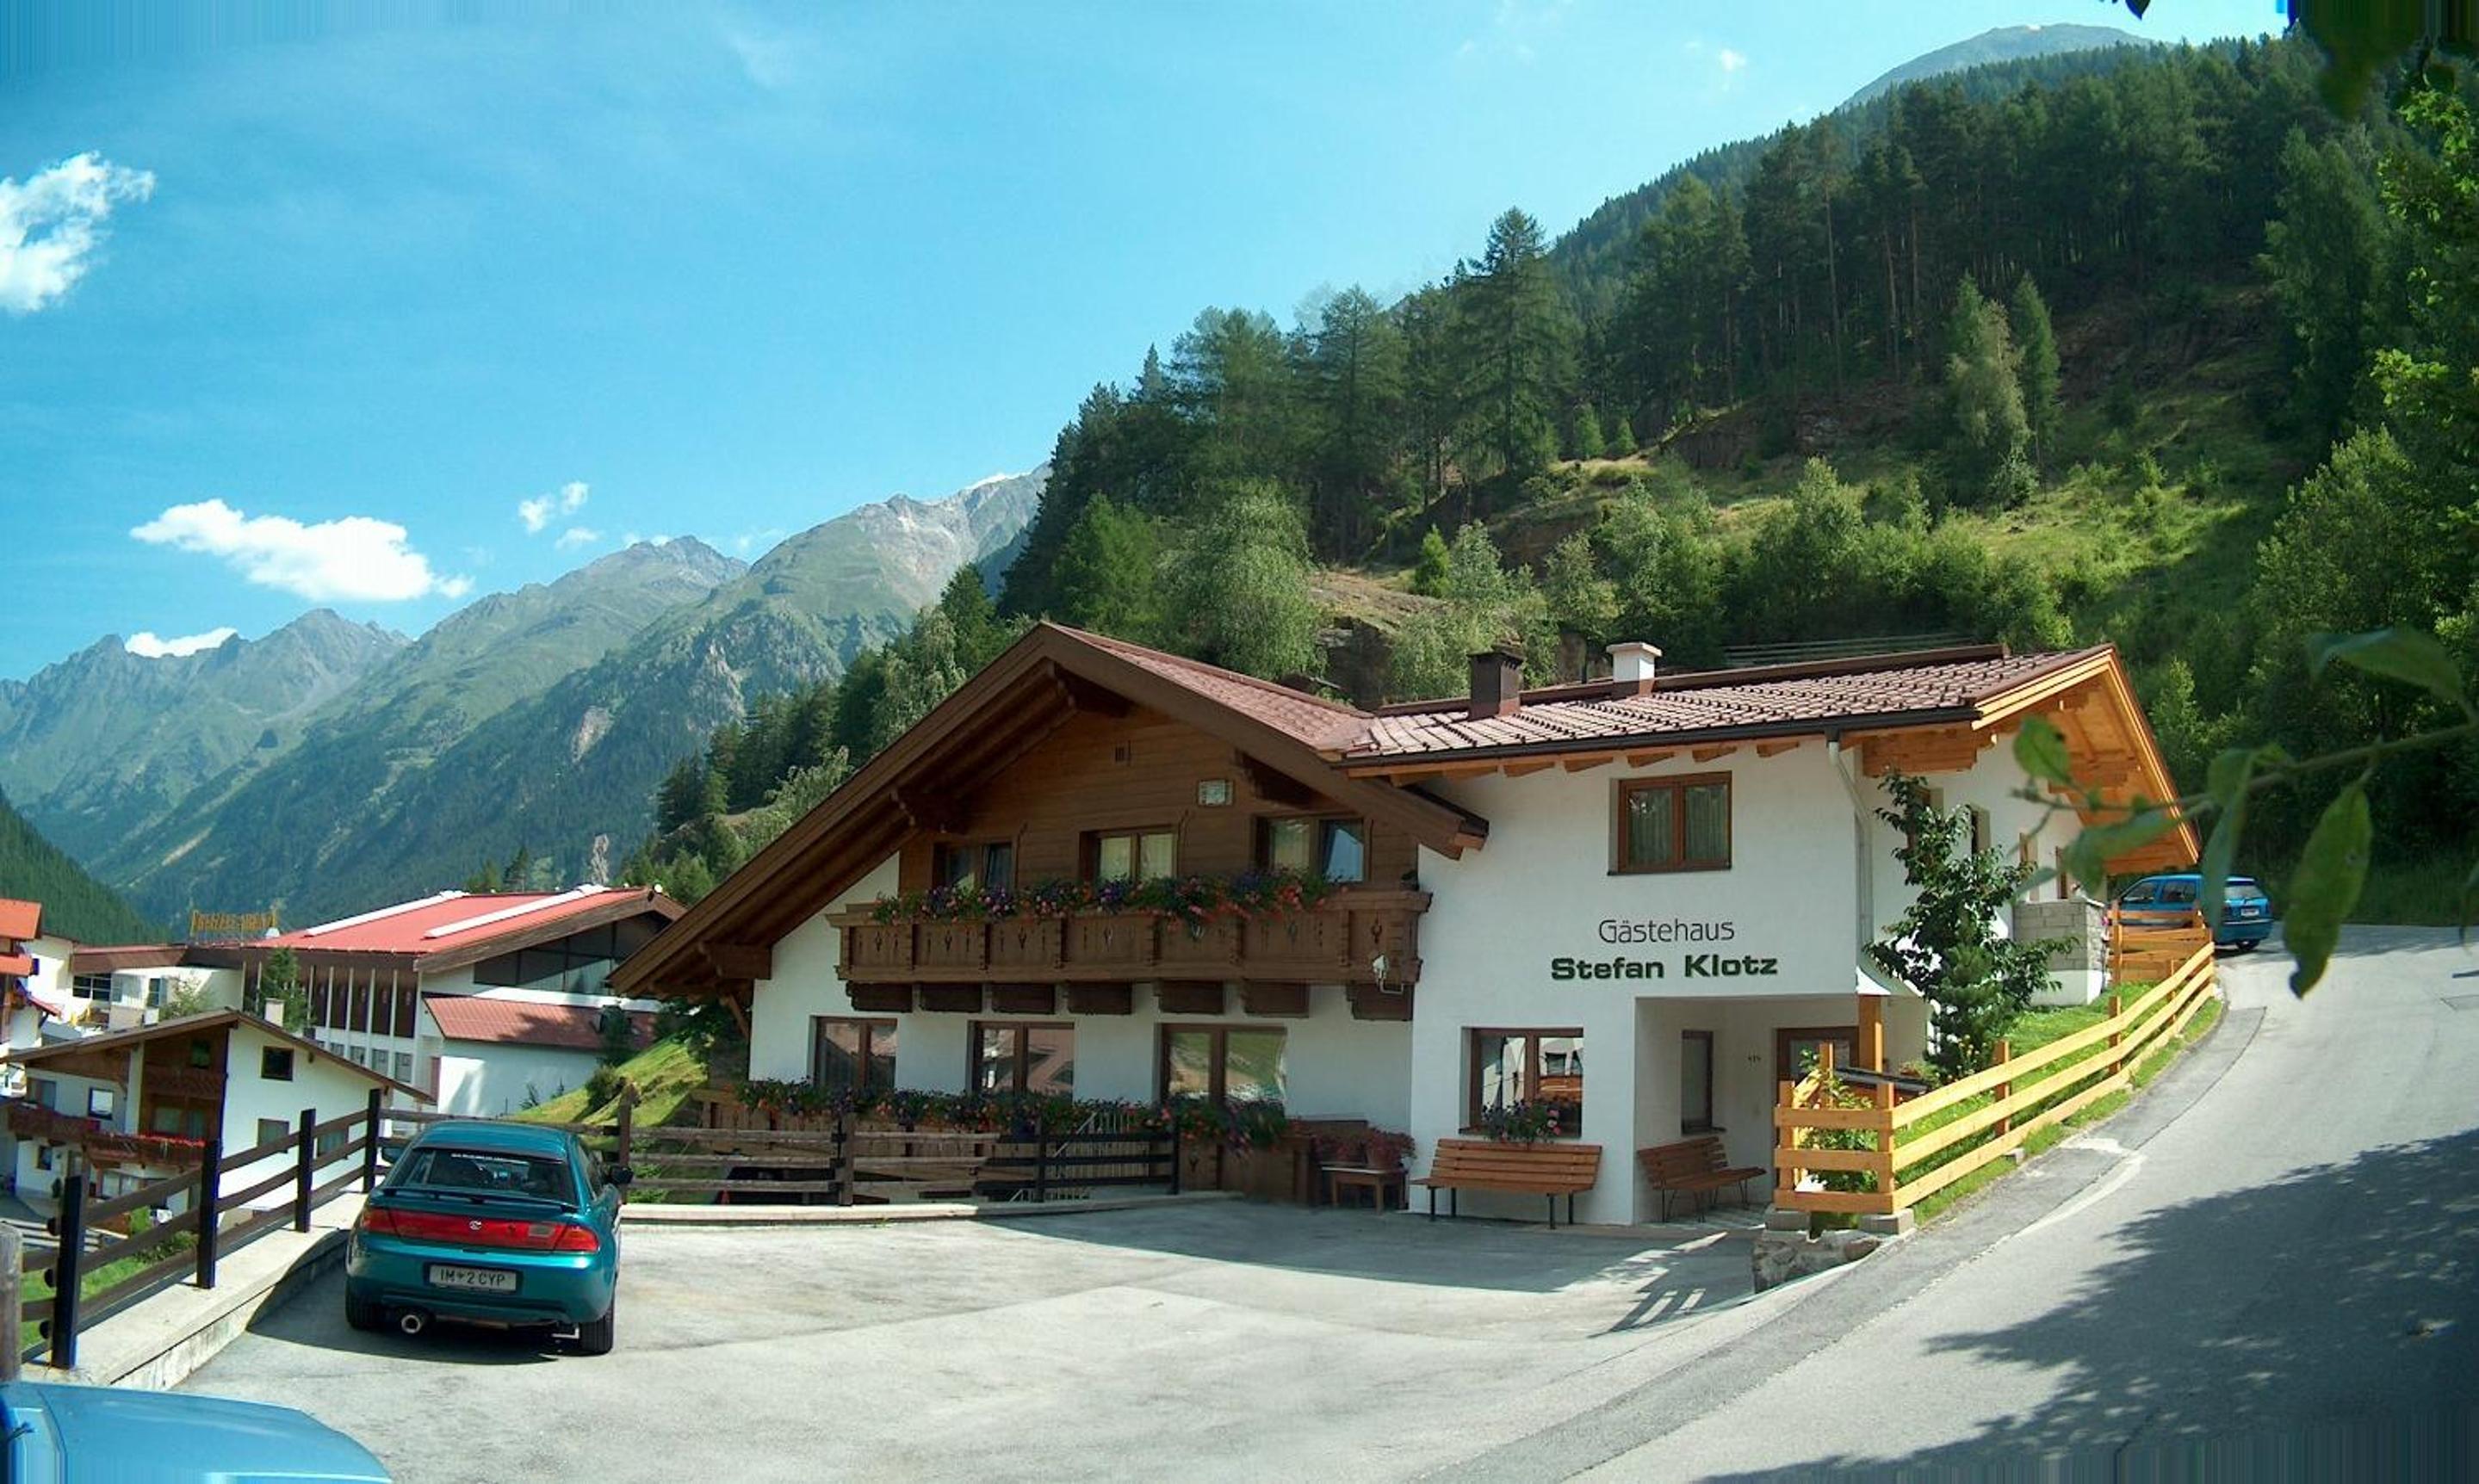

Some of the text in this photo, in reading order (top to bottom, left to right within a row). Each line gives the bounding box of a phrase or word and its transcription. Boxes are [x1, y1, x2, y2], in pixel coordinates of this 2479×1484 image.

[1598, 918, 1735, 944] Gästehaus
[1551, 954, 1779, 980] Stefan Klotz
